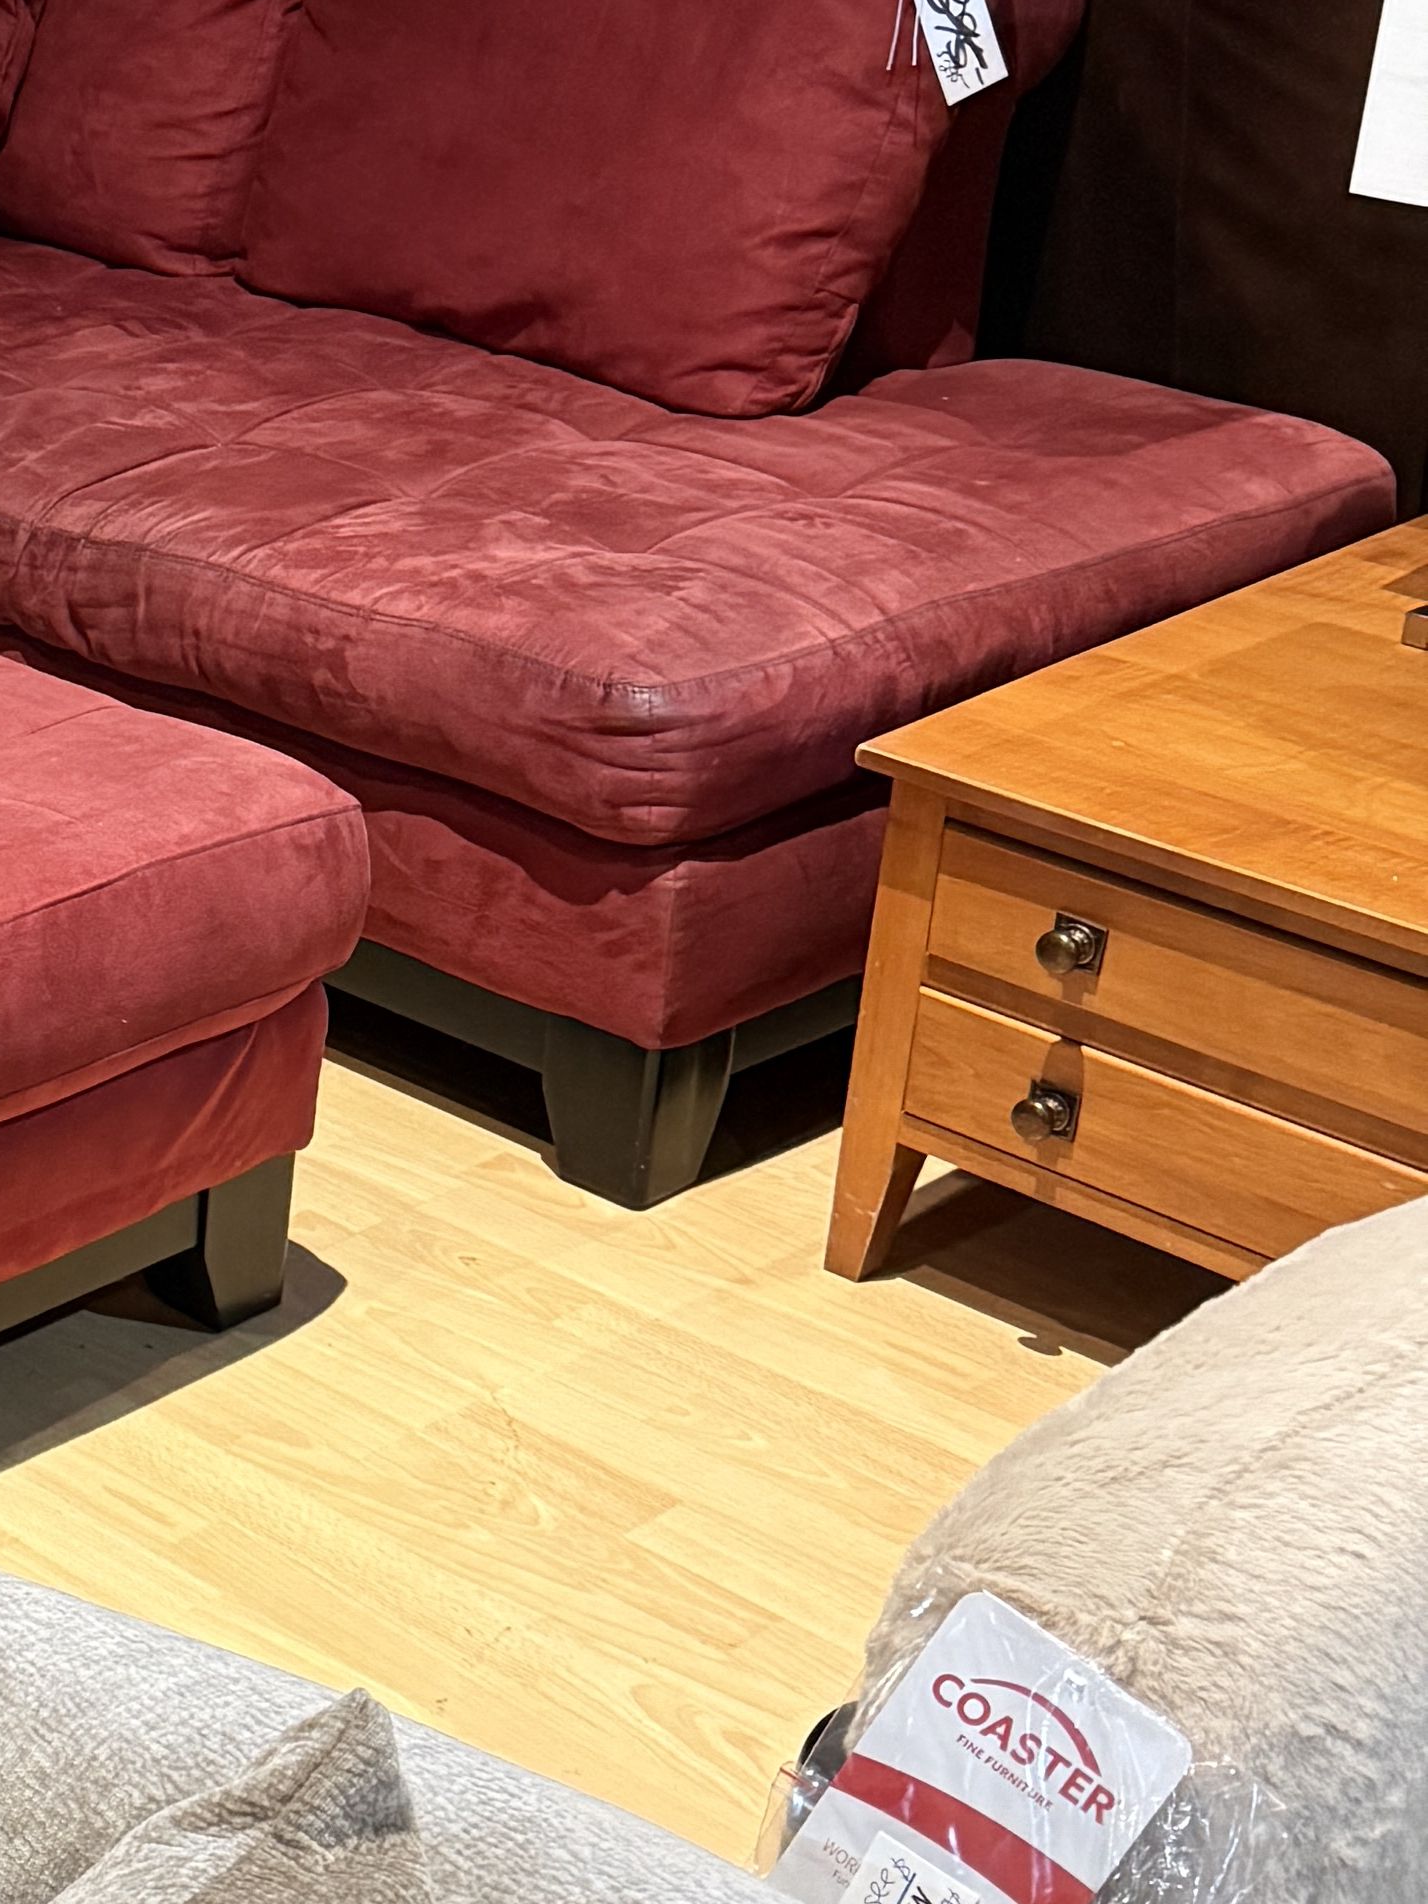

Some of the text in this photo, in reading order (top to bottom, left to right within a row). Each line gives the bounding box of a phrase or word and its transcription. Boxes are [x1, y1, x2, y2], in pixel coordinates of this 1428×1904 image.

[932, 1673, 1115, 1825] COASTER
[956, 1734, 1054, 1812] FINE FURNITURE
[822, 1838, 861, 1874] WOR
